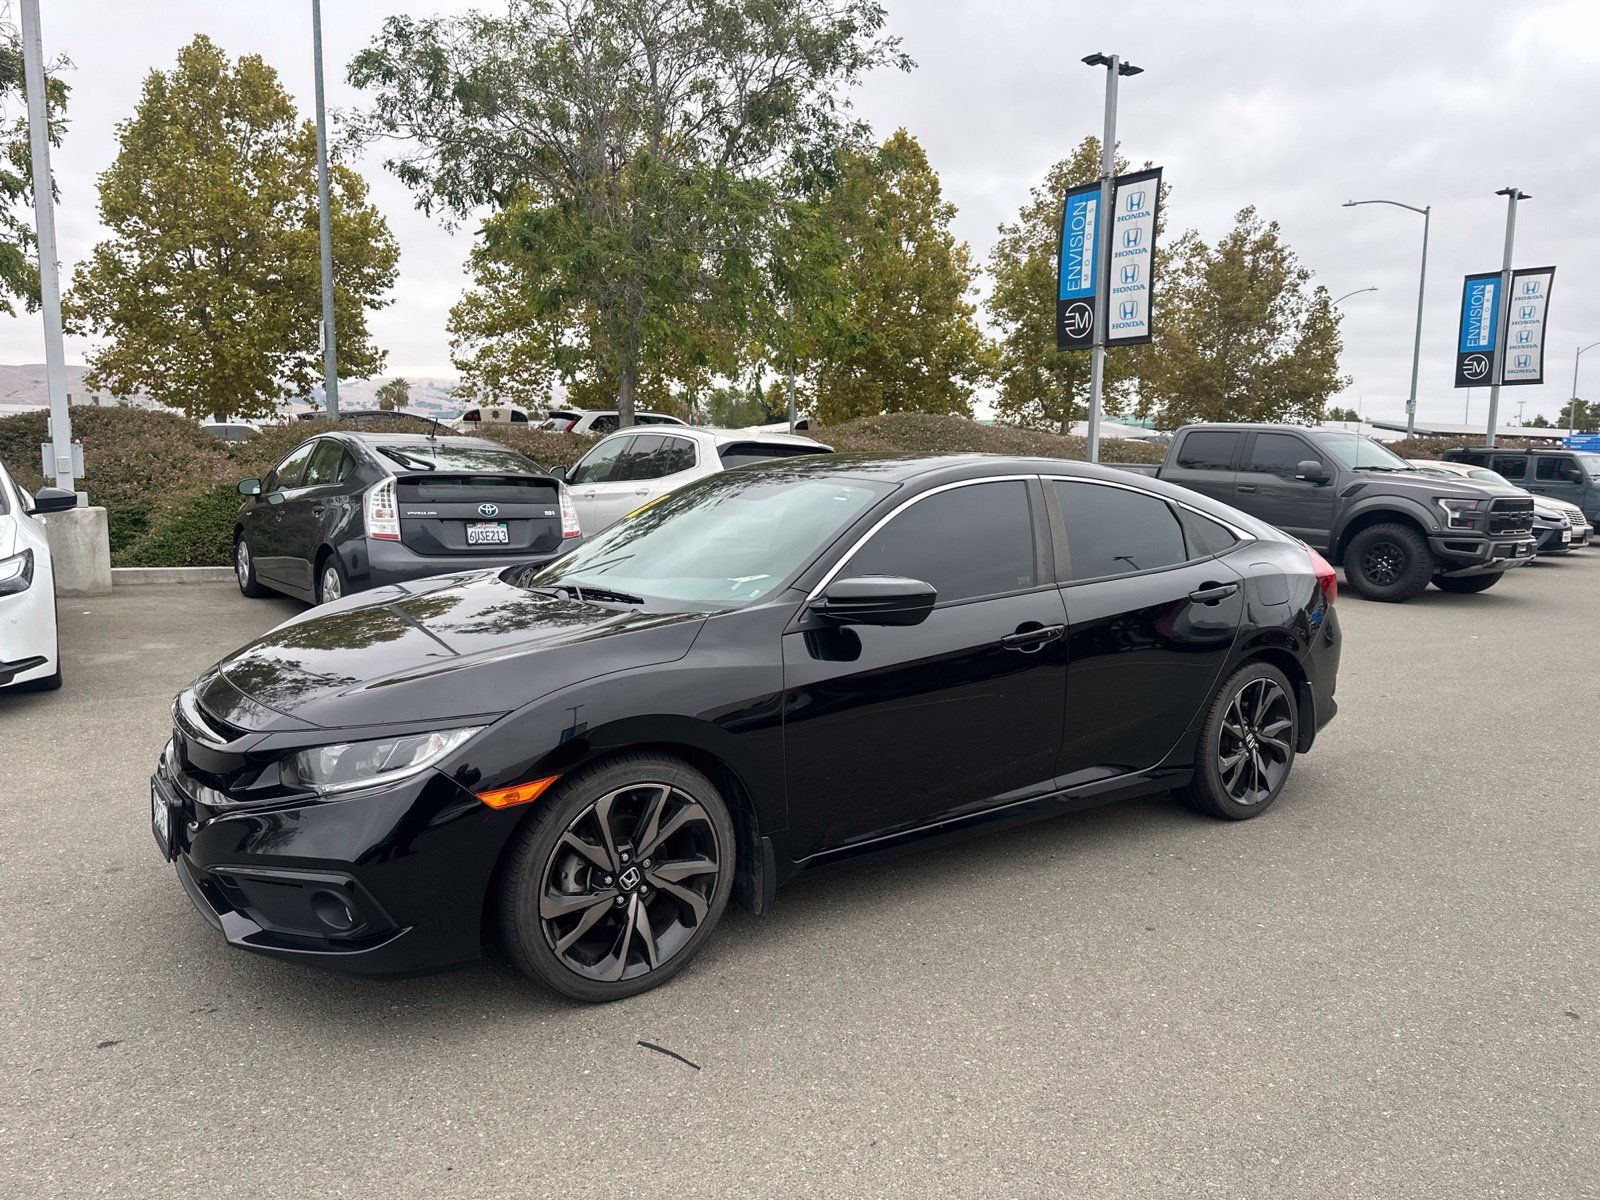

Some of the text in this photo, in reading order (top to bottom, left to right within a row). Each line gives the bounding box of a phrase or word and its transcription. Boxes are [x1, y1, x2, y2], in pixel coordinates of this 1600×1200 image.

[1117, 211, 1151, 222] HONDA
[1067, 201, 1087, 291] ENVISION
[1083, 208, 1094, 282] MOTORS
[1114, 247, 1148, 258] HONDA
[1112, 284, 1146, 294] HONDA
[1467, 284, 1485, 347] ENVISION
[1112, 320, 1145, 330] HONDA
[469, 530, 507, 542] 6USE213
